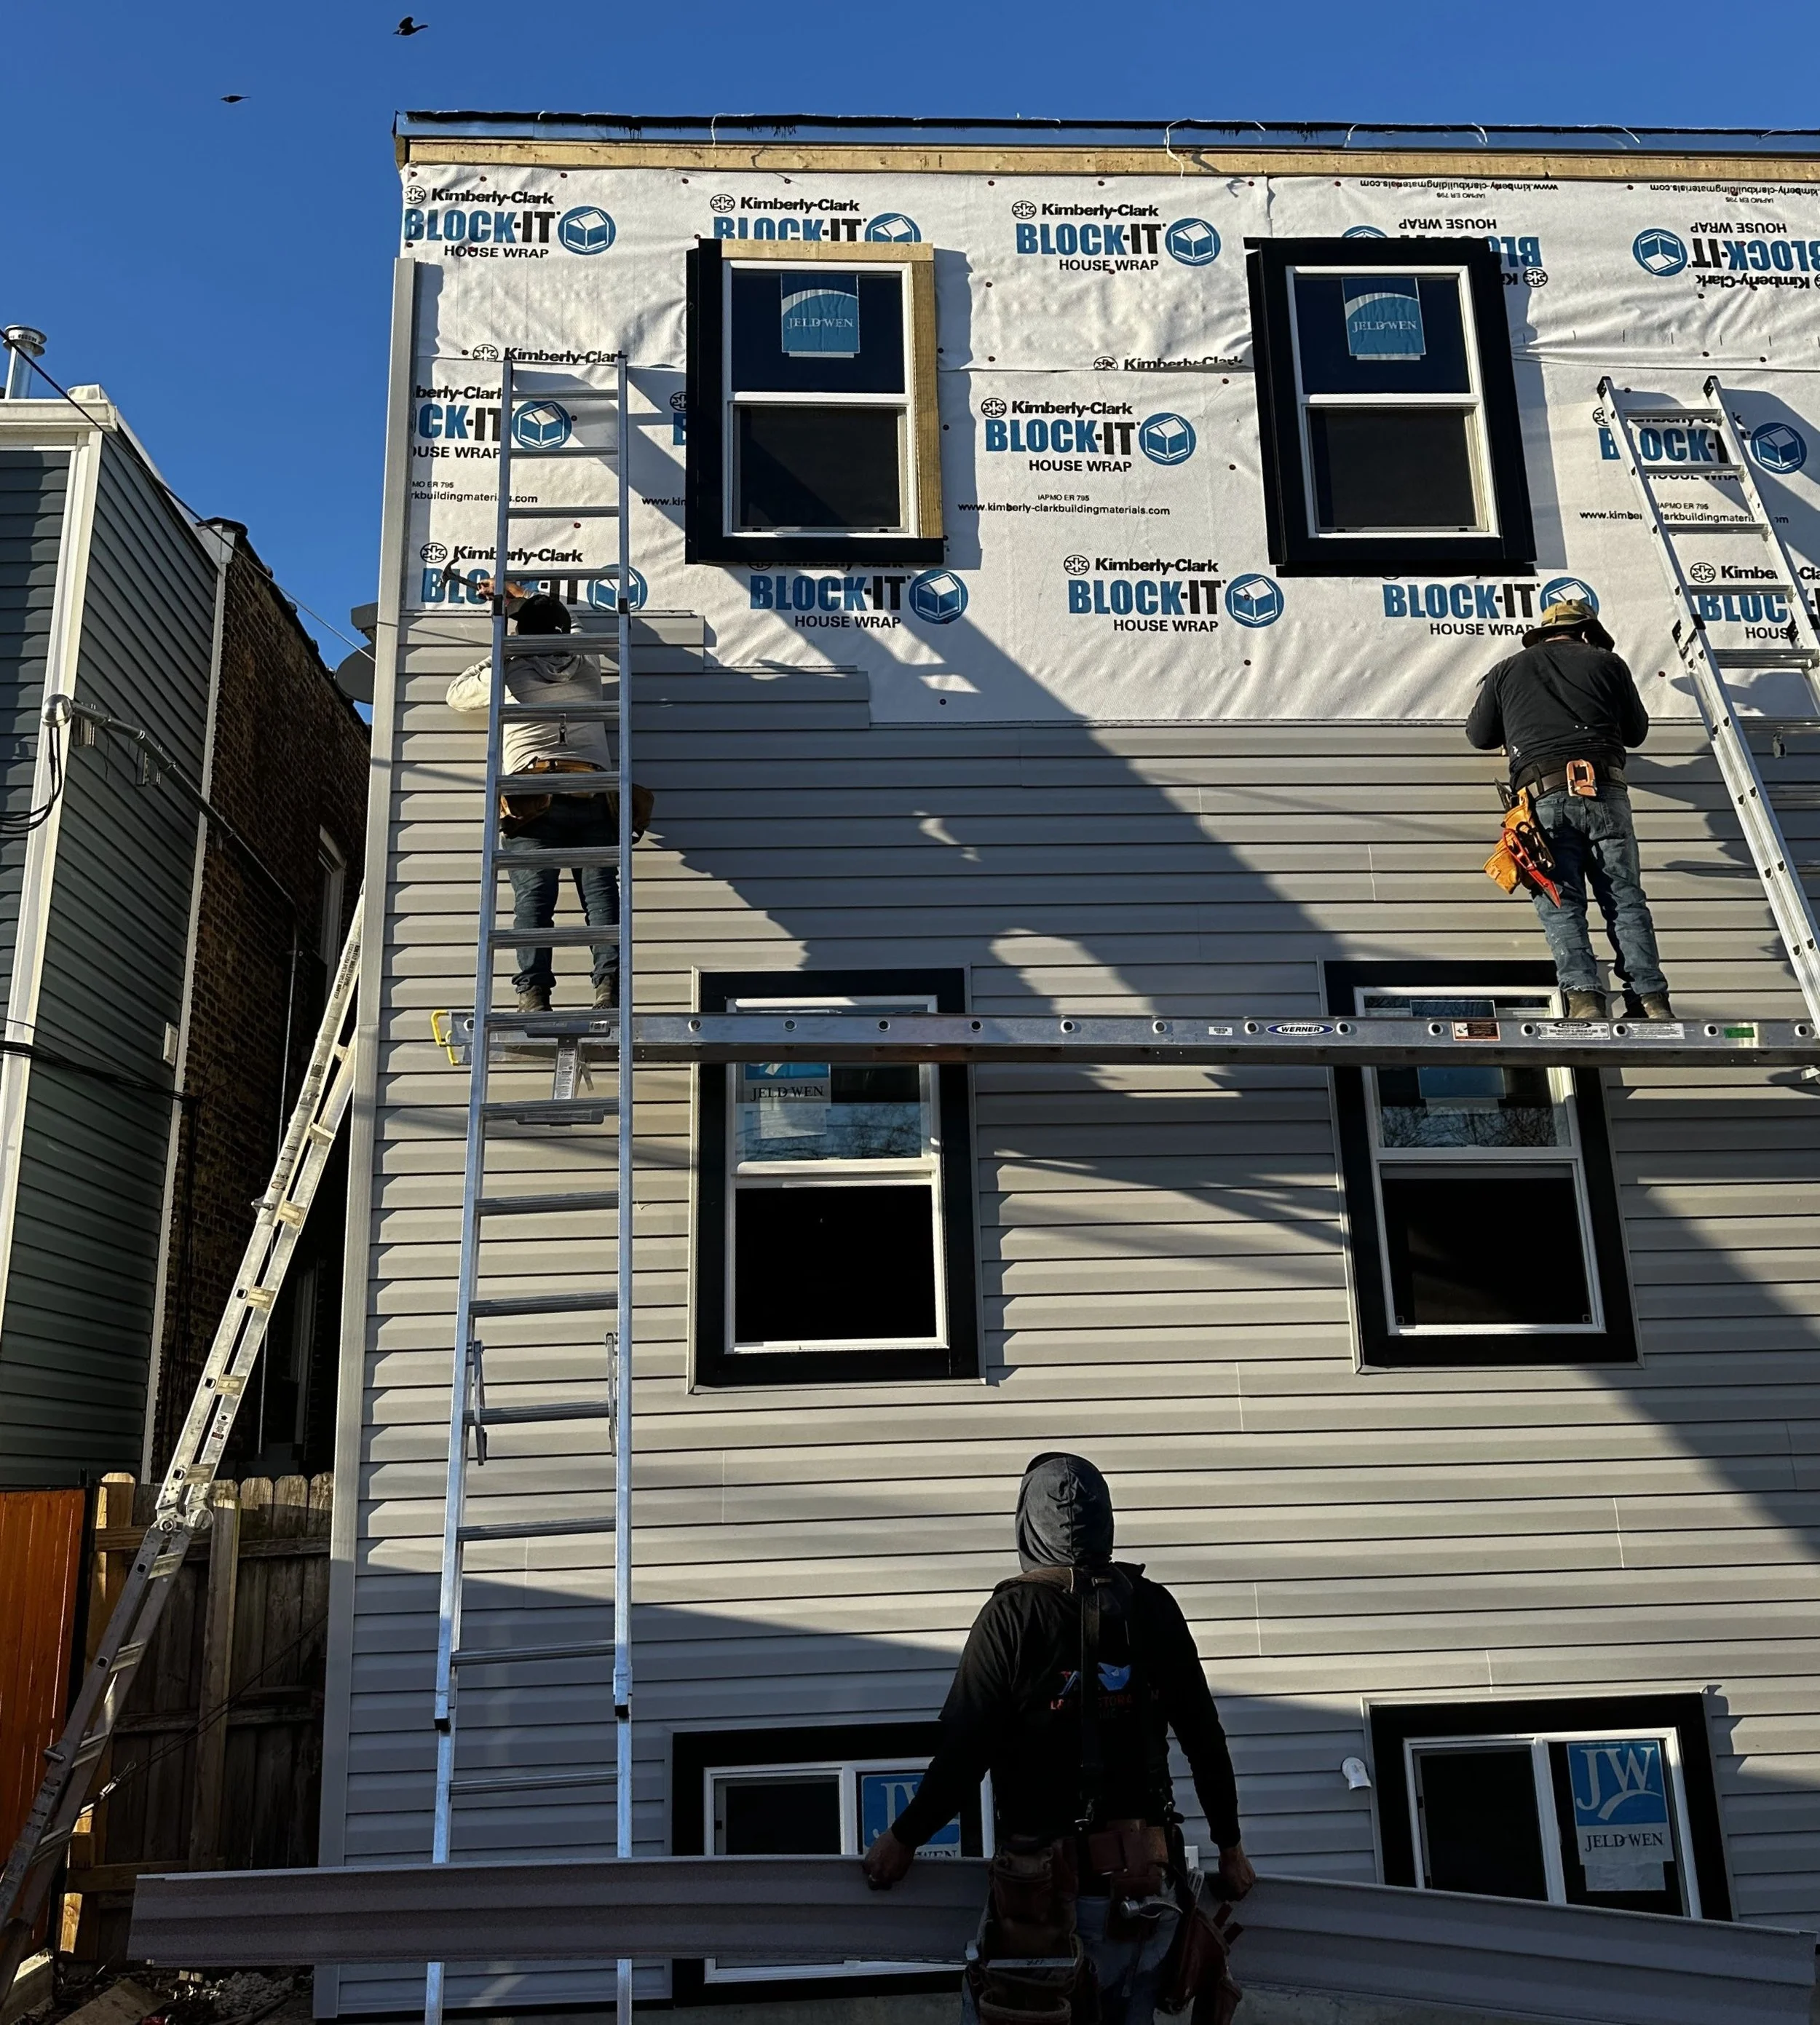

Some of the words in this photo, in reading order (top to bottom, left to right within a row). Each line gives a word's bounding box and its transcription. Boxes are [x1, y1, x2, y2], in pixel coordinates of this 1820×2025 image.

[431, 188, 555, 207] Kimberly-Clark
[740, 197, 860, 214] Kimberly-Clark
[1042, 203, 1159, 220] Kimberly-Clark
[404, 208, 555, 243] BLOCK-IT
[713, 216, 862, 242] BLOCK-IT
[1398, 218, 1442, 229] WRAP
[1446, 218, 1497, 229] HOUSE
[1690, 221, 1733, 233] WRAP
[1737, 223, 1787, 234] HOUSE
[1016, 223, 1162, 256] BLOCK-IT
[444, 245, 499, 258] HOUSE
[503, 248, 549, 258] WRAP
[1059, 259, 1110, 271] HOUSE
[1115, 259, 1159, 271] WRAP
[1696, 274, 1811, 289] Kimberly-Clark
[1011, 400, 1133, 417] Kimberly-Clark
[985, 419, 1136, 456] BLOCK-IT
[1029, 459, 1083, 472] HOUSE
[1087, 460, 1132, 473] WRAP
[957, 502, 1170, 516] www.kimberly-clarkbuildingmaterials.com
[1095, 558, 1219, 575] Kimberly-Clark
[750, 575, 906, 612] BLOCK-IT
[1068, 579, 1222, 615] BLOCK-IT
[1382, 583, 1536, 619] BLOCK-IT
[794, 615, 850, 628] HOUSE
[854, 616, 901, 628] WRAP
[1114, 620, 1168, 631] HOUSE
[1172, 620, 1219, 633] WRAP
[1430, 623, 1484, 635] HOUSE
[1745, 627, 1789, 639] HOUS
